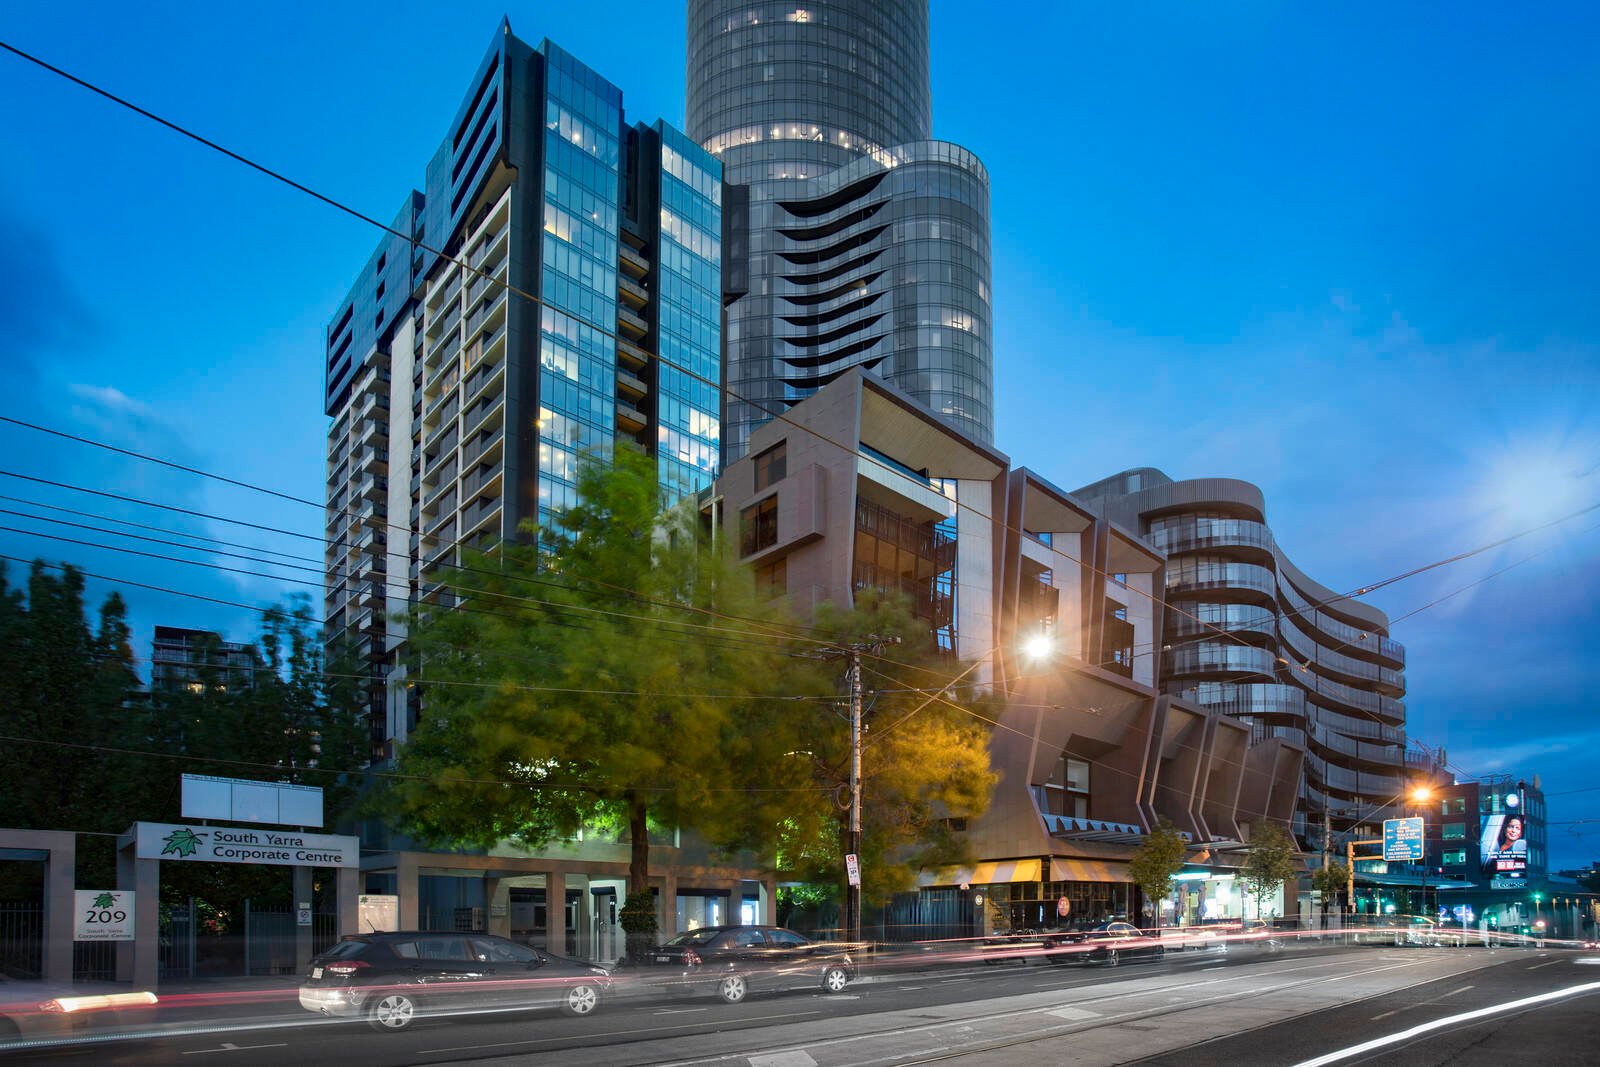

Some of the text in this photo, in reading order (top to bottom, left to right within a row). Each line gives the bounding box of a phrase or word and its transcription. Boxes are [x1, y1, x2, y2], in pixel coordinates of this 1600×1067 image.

[213, 831, 304, 847] South Yarra
[213, 846, 342, 863] Corporate Centre
[86, 910, 126, 923] 209
